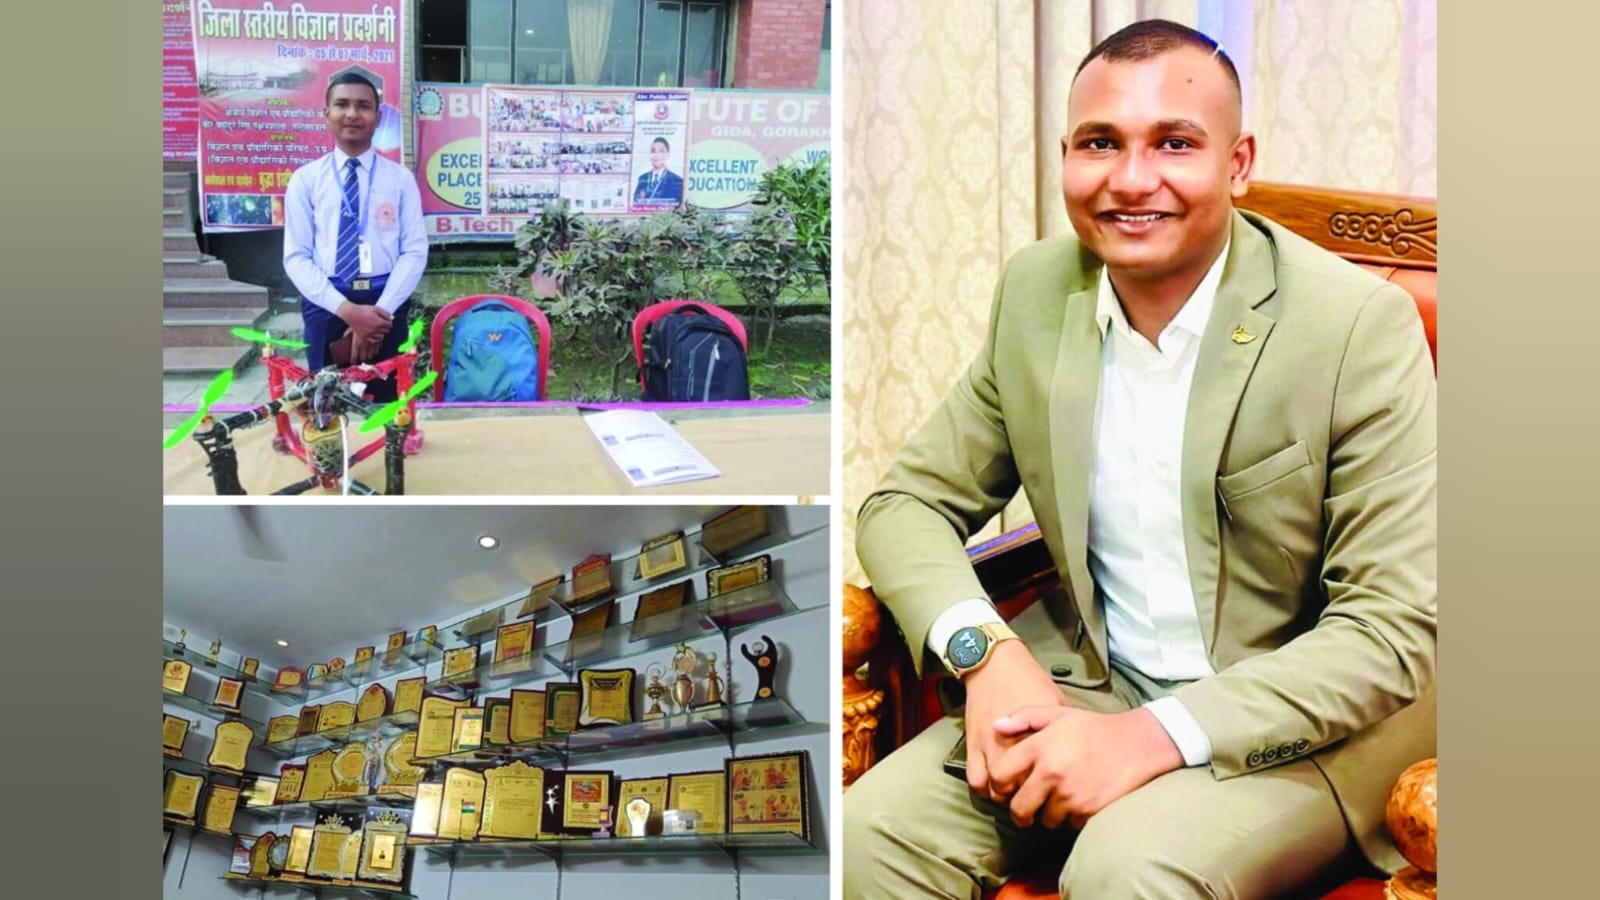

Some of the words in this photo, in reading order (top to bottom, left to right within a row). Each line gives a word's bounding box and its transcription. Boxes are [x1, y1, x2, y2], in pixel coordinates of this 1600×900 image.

[199, 0, 240, 38] जिला
[243, 2, 289, 40] स्तरीय
[291, 3, 339, 41] विज्ञान
[343, 4, 396, 43] प्रदर्शनी
[277, 45, 306, 58] दिनांक
[374, 51, 394, 61] 2021
[777, 97, 820, 123] OF
[711, 126, 757, 138] GIDA,
[807, 150, 831, 164] WO
[436, 216, 514, 233] B.Tech
